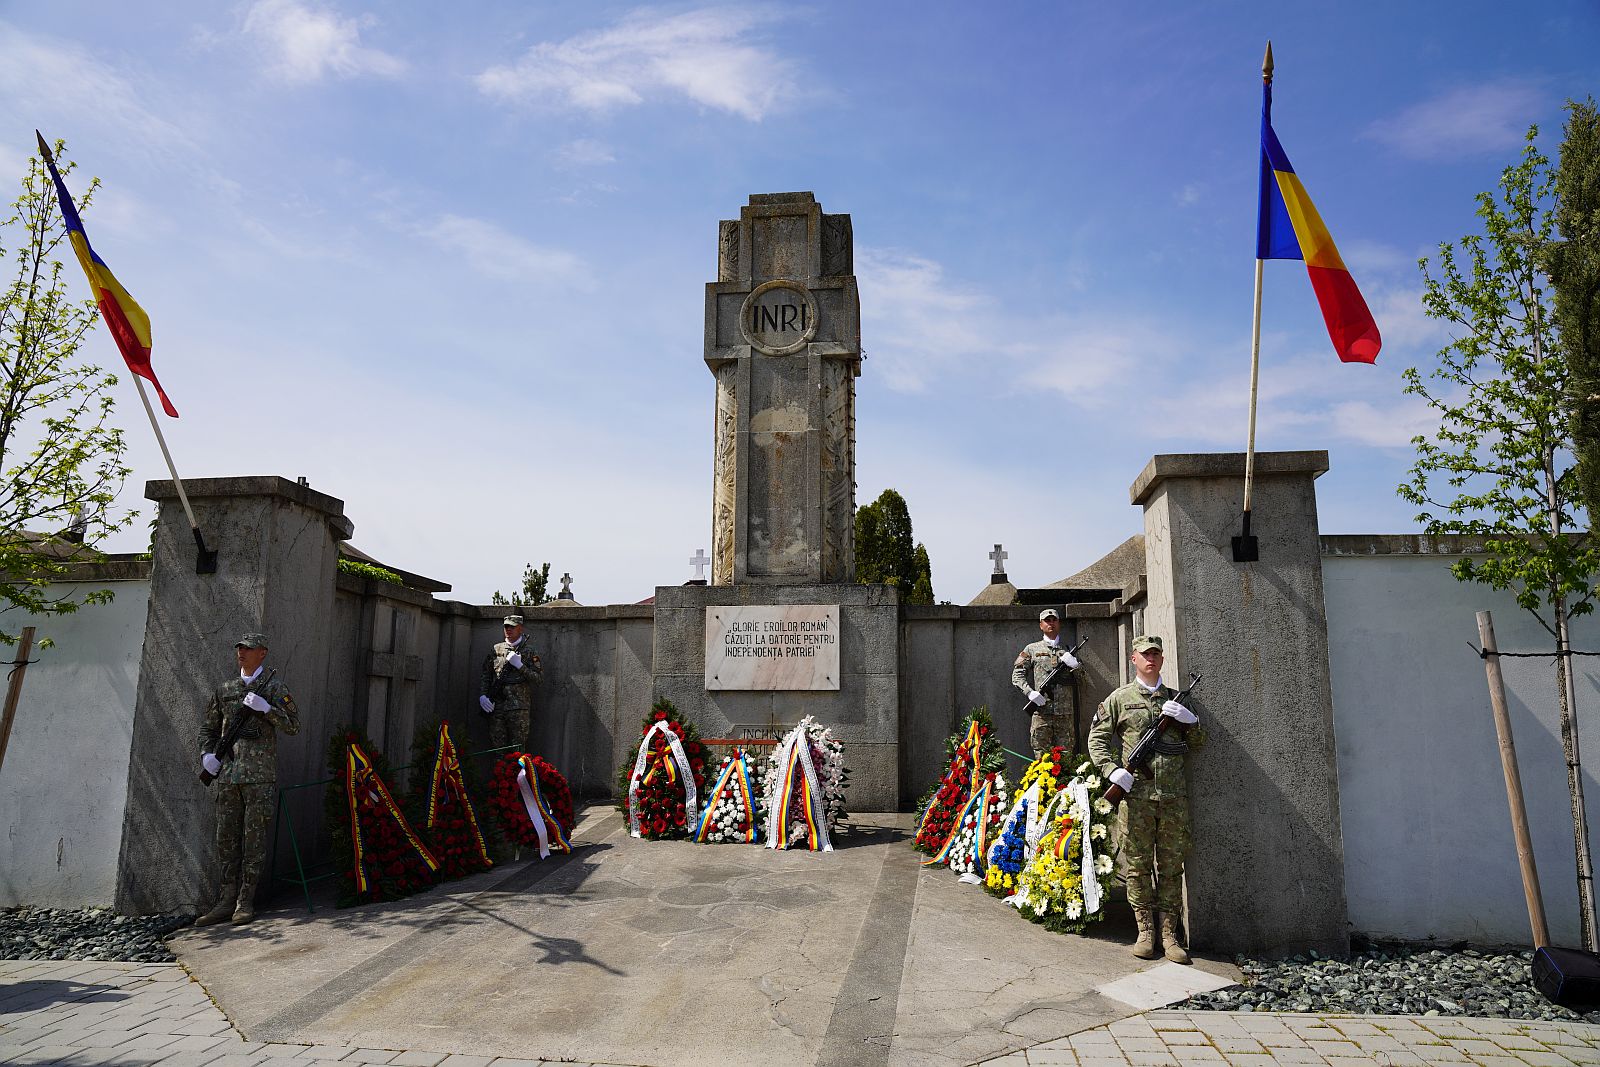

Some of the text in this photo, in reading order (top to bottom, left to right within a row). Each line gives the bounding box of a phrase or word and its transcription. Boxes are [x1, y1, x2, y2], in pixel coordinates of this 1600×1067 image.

[753, 303, 807, 333] INRI
[763, 619, 798, 632] EROILOR
[755, 634, 766, 645] LA
[769, 632, 802, 645] DATORIE
[803, 634, 835, 645] PENTRU
